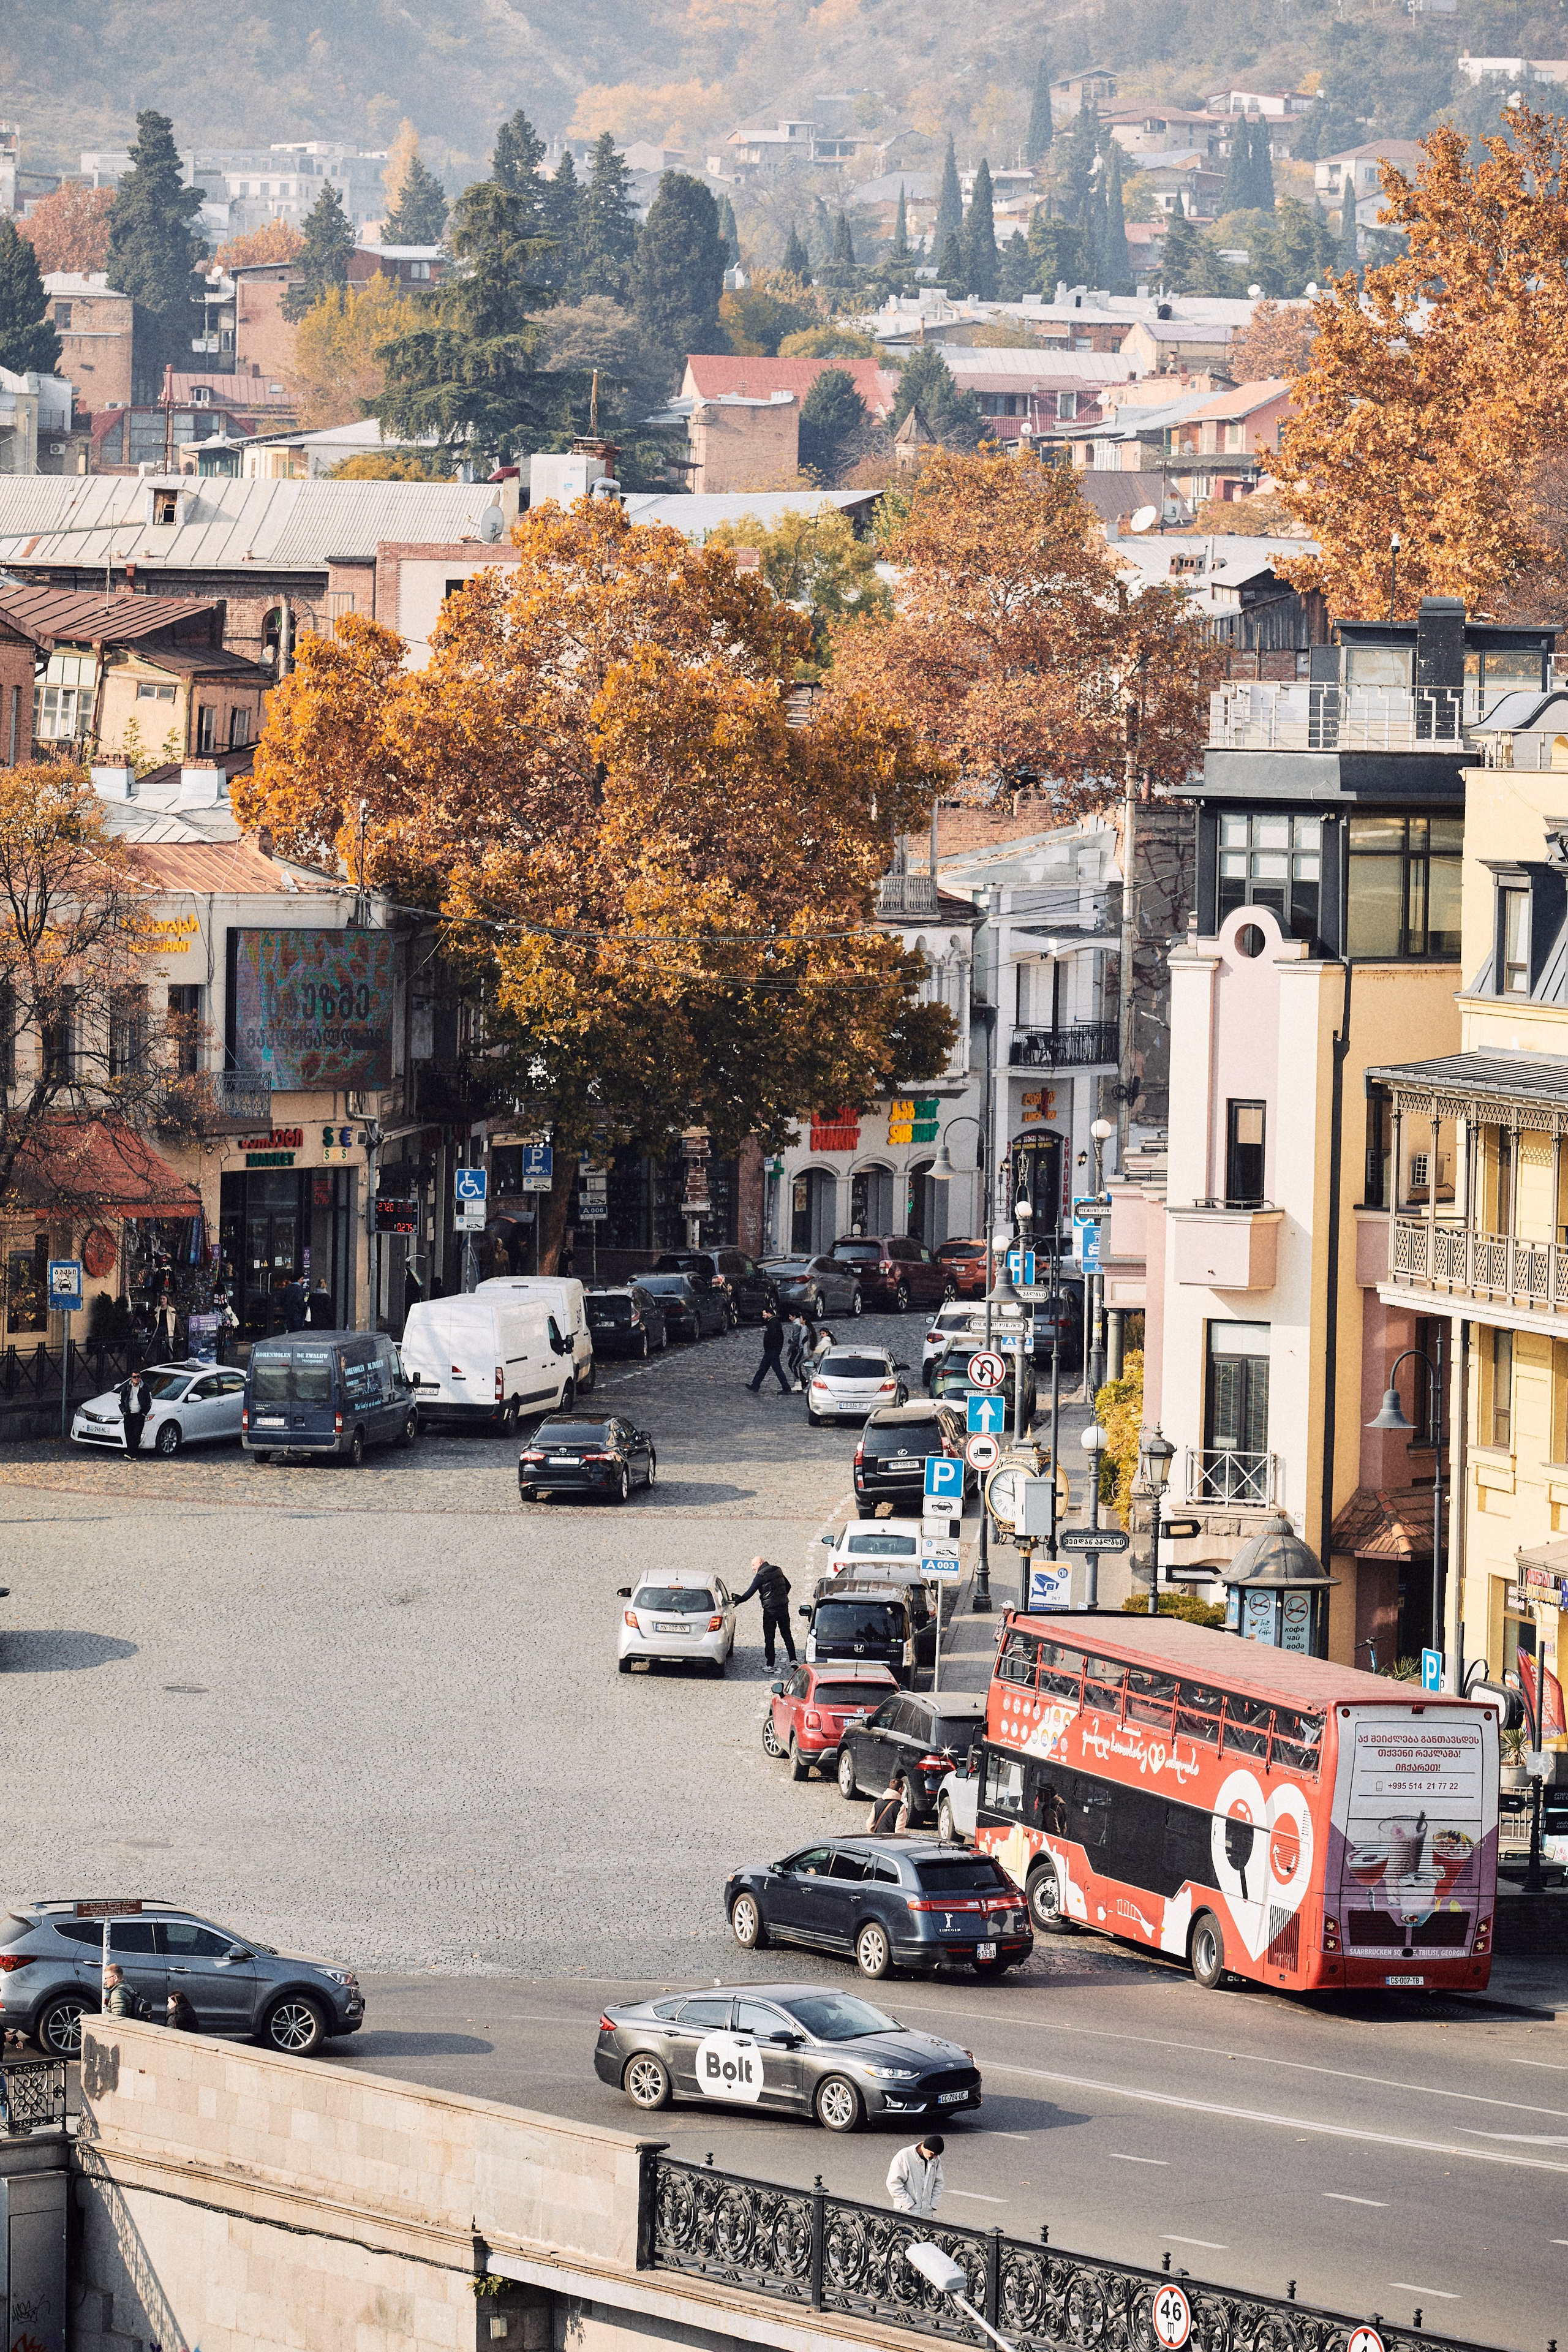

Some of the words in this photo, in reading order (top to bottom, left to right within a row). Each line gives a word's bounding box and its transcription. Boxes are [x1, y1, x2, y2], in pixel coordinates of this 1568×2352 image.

[1046, 1110, 1057, 1120] YOU
[888, 1121, 940, 1145] SUBWAY
[246, 1153, 296, 1167] MARKET
[532, 1148, 544, 1166] P
[933, 1461, 956, 1493] P
[925, 1561, 936, 1569] A
[937, 1561, 955, 1570] 003
[706, 2051, 753, 2084] Bolt
[941, 2092, 965, 2103] CC-784-UC
